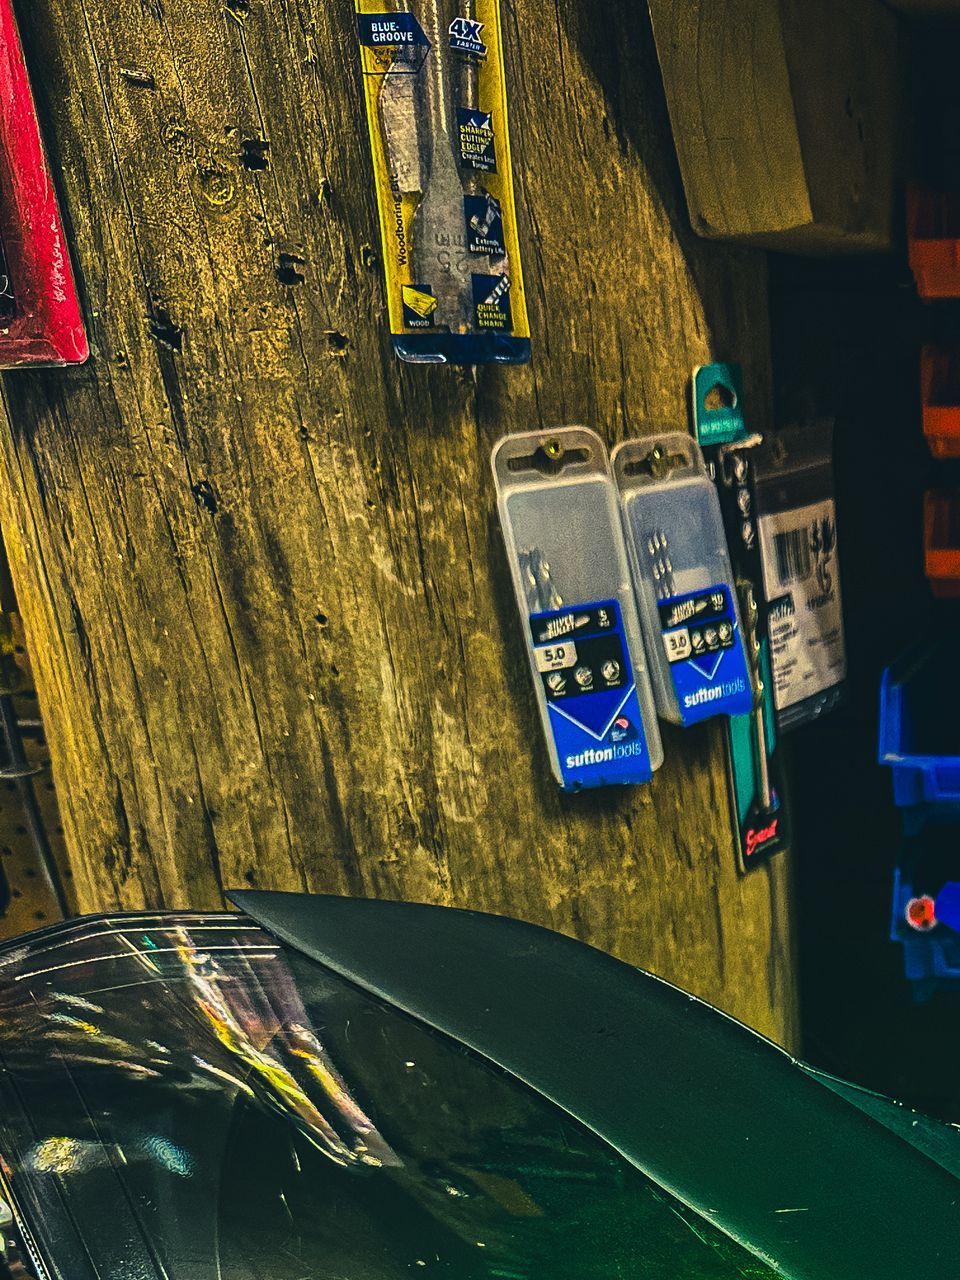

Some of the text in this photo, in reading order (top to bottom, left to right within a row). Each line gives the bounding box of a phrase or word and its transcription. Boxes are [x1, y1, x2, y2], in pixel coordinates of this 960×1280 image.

[371, 21, 400, 32] BLUE-
[450, 18, 485, 43] 4X
[372, 31, 414, 42] GROOVE
[392, 195, 407, 266] Woodboring
[545, 647, 566, 662] 5.0
